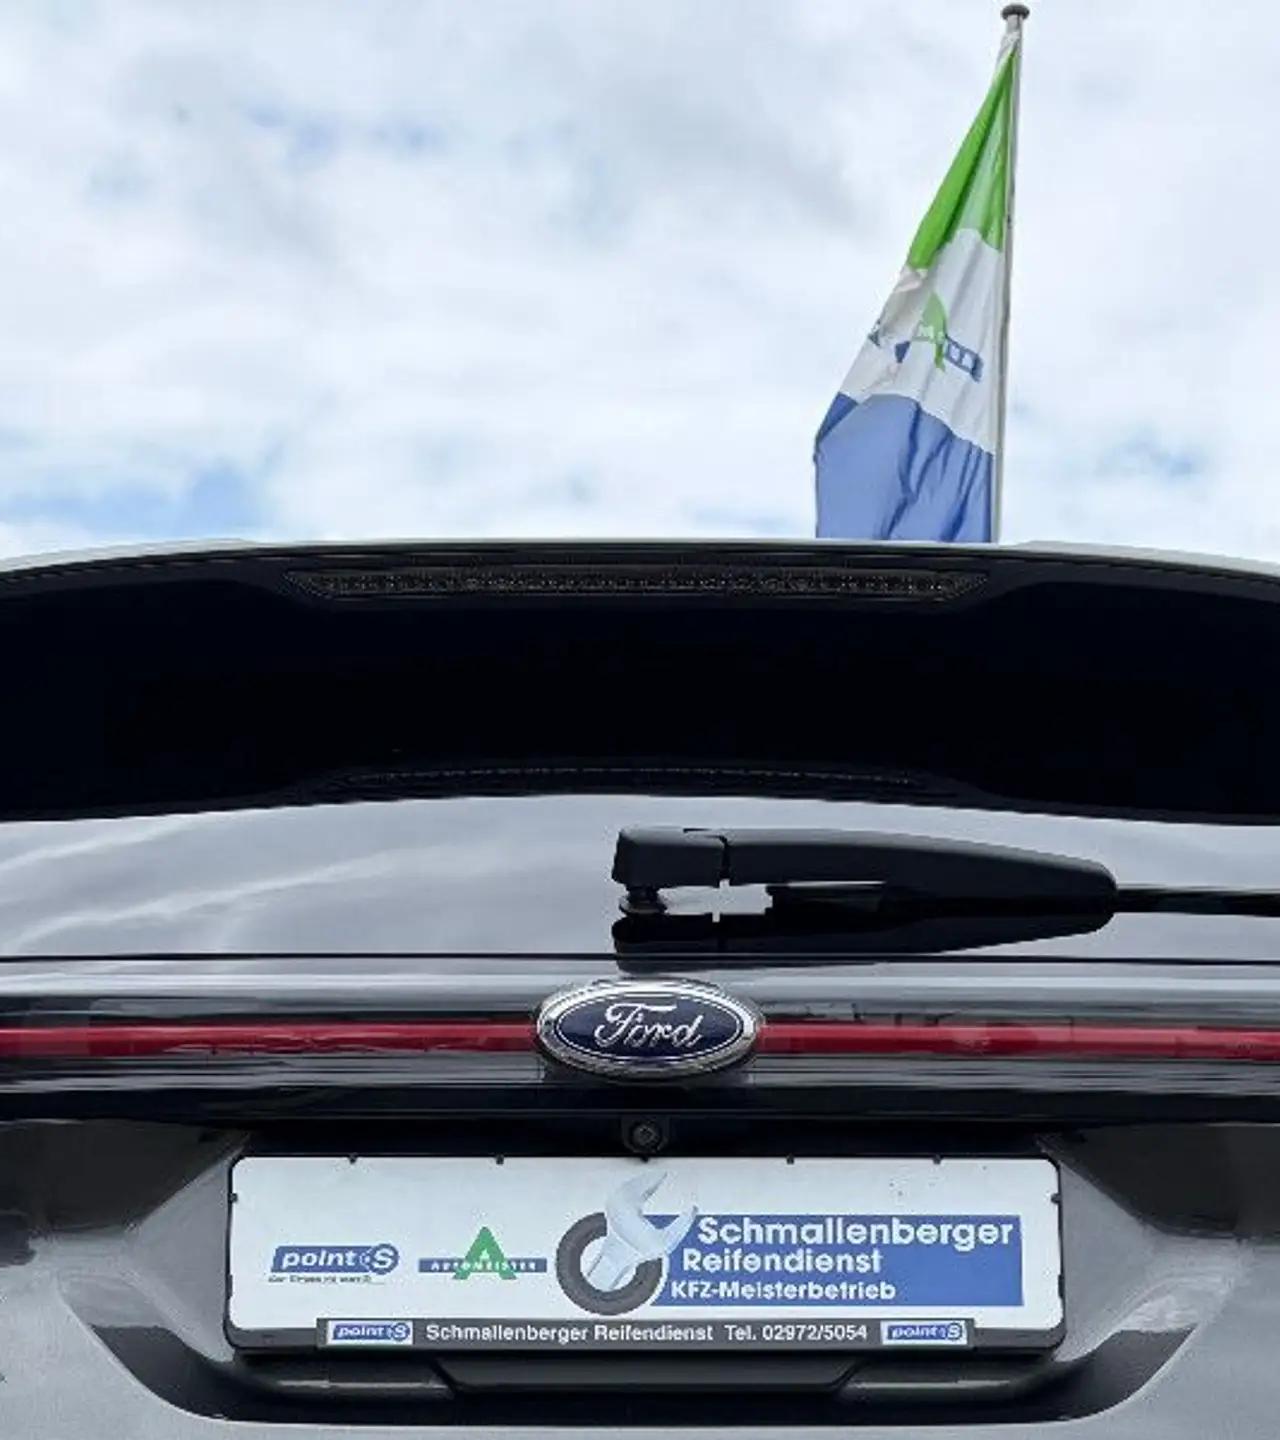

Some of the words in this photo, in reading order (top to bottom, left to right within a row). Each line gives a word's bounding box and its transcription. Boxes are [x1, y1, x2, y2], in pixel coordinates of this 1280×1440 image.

[594, 1002, 704, 1048] Ford
[697, 1216, 1014, 1252] Schmallenberger
[282, 1248, 356, 1269] point
[683, 1248, 884, 1273] Reifendienst
[671, 1280, 897, 1301] KFZ-Meisterbetrieb
[425, 1323, 589, 1345] Schmallenberger
[594, 1323, 714, 1341] Reifendienst
[724, 1324, 756, 1341] Tel.
[762, 1324, 868, 1341] 02972/5054
